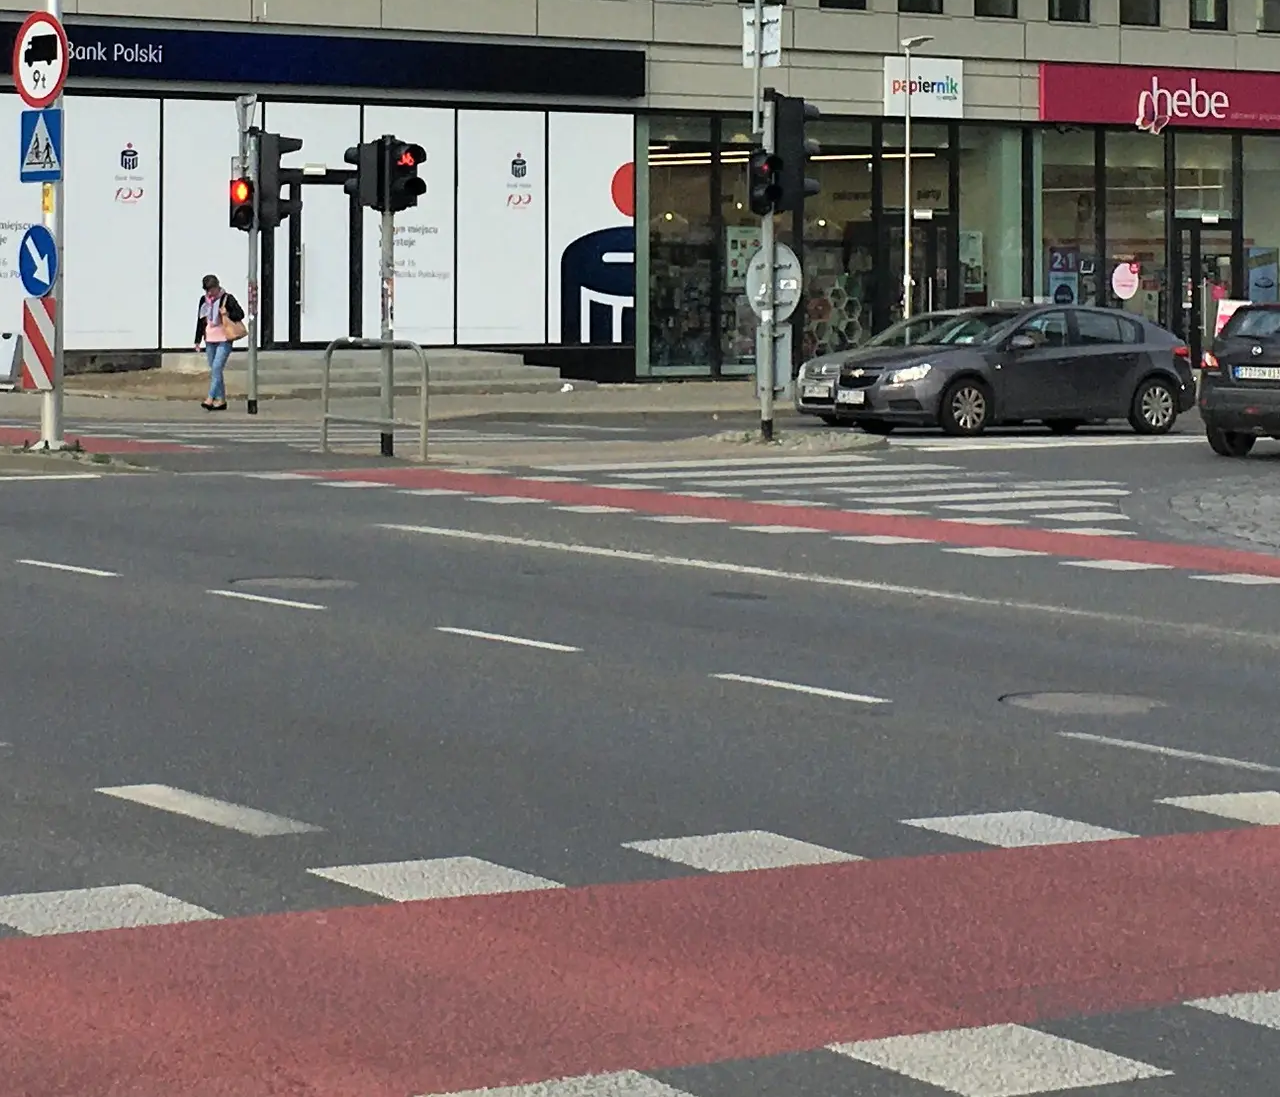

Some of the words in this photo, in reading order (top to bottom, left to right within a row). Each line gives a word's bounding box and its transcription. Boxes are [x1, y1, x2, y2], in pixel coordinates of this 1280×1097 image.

[67, 41, 107, 61] Bank
[114, 43, 163, 63] Polski
[33, 70, 41, 90] 9
[41, 74, 46, 89] t
[892, 75, 959, 95] papiernik
[1152, 76, 1229, 119] hebe
